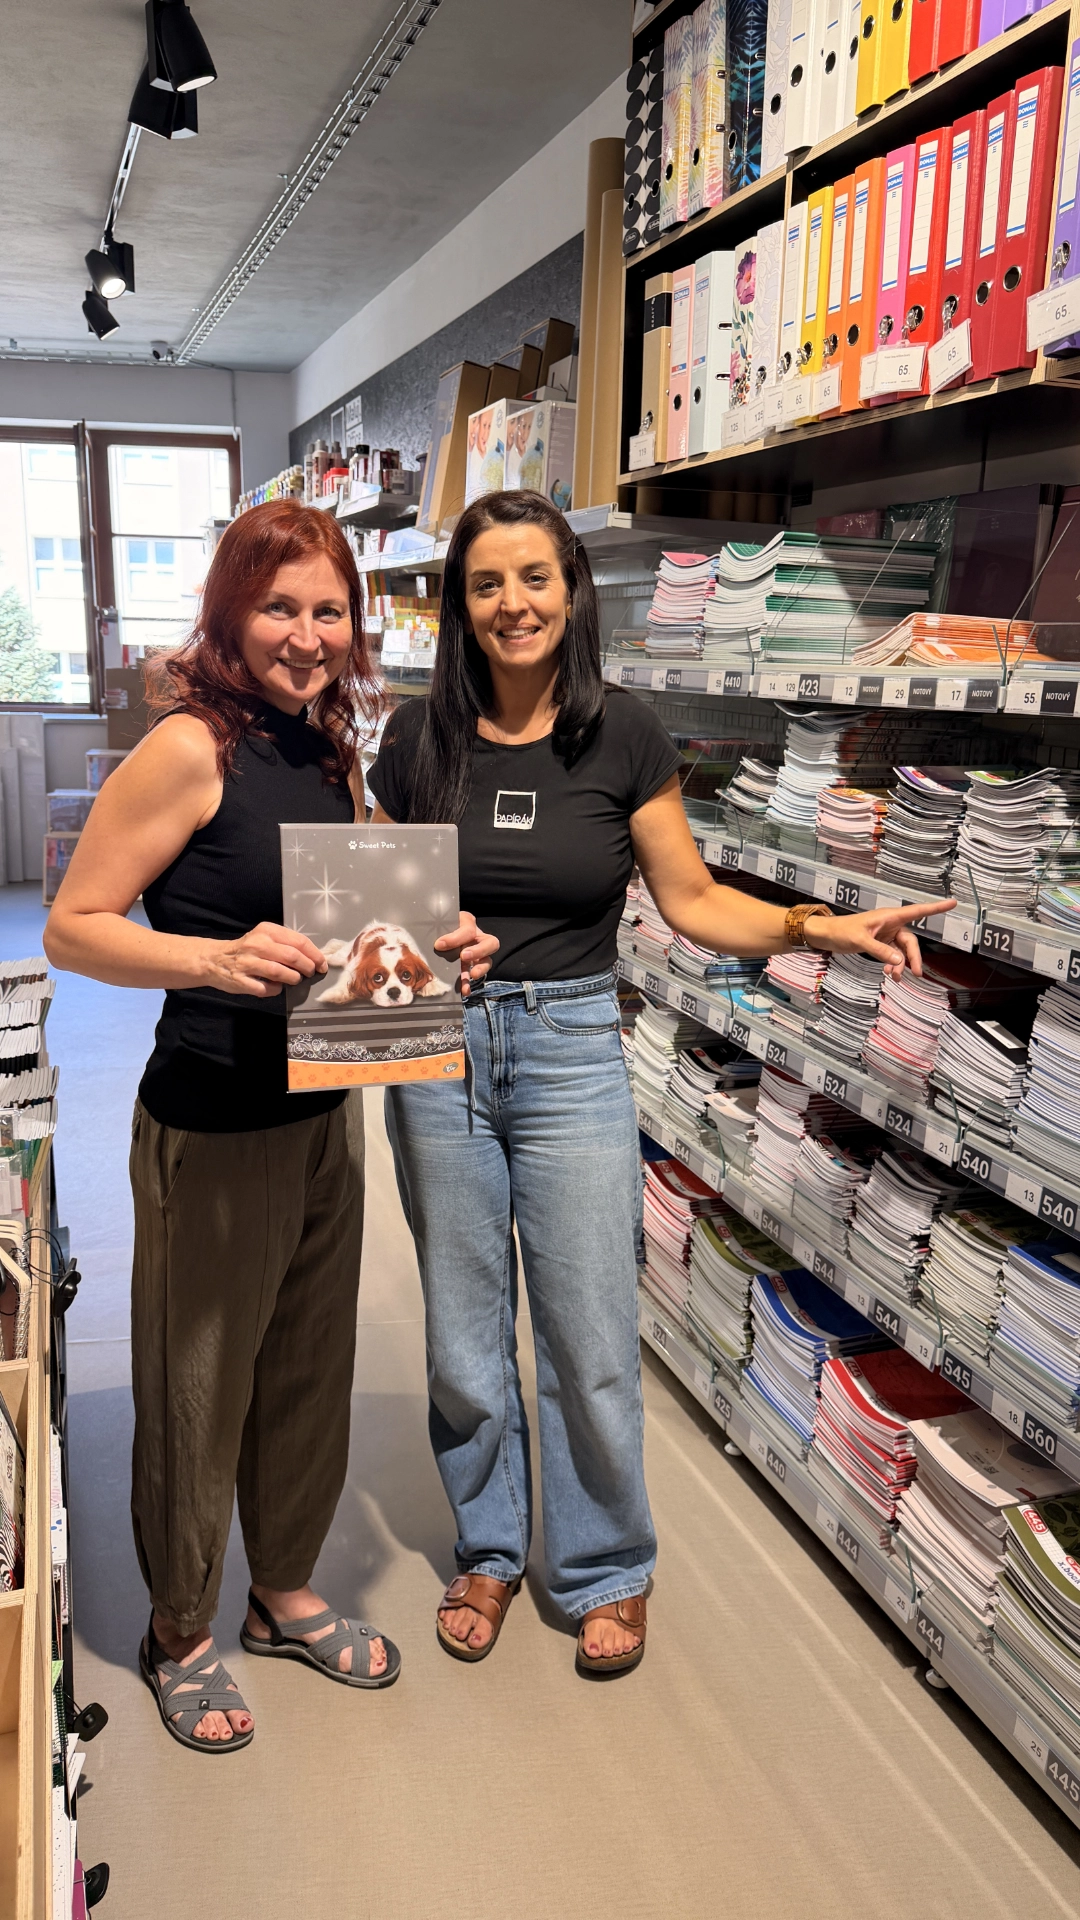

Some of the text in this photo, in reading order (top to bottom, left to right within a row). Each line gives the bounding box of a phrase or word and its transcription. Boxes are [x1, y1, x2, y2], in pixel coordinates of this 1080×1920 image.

[1017, 103, 1037, 117] DONAU
[898, 365, 910, 376] 65.
[666, 673, 681, 685] 4210
[725, 675, 741, 688] 4410
[800, 679, 819, 696] 423
[895, 689, 906, 699] 29.
[912, 687, 932, 696] NOTOVÝ
[952, 690, 963, 701] 17.
[972, 690, 994, 698] NOTOVÝ
[1024, 692, 1038, 704] 55.
[1045, 692, 1071, 701] NOTOVÝ
[496, 812, 533, 825] PAPÍRÁK
[722, 850, 738, 866] 512
[777, 864, 795, 883] 512
[837, 885, 858, 906] 512
[983, 929, 1010, 952] 512
[1057, 959, 1066, 971] 8.
[646, 975, 658, 992] 523
[682, 996, 696, 1014] 523
[731, 1024, 749, 1045] 524
[768, 1044, 786, 1066] 524
[824, 1076, 846, 1099] 524
[639, 1113, 652, 1132] 544
[887, 1110, 911, 1136] 524
[675, 1142, 690, 1162] 544
[939, 1142, 950, 1156] 21.
[960, 1150, 989, 1180] 540
[1024, 1189, 1036, 1204] 13.
[1042, 1195, 1074, 1228] 540
[762, 1214, 779, 1238] 544
[814, 1256, 834, 1283] 544
[876, 1308, 898, 1335] 544
[943, 1356, 971, 1389] 545
[715, 1394, 731, 1419] 425
[1008, 1411, 1020, 1427] 18.
[1025, 1419, 1055, 1455] 560
[767, 1454, 785, 1478] 440
[1028, 1511, 1046, 1531] 445
[837, 1530, 858, 1560] 444
[918, 1618, 943, 1652] 444
[1048, 1762, 1080, 1802] 445
